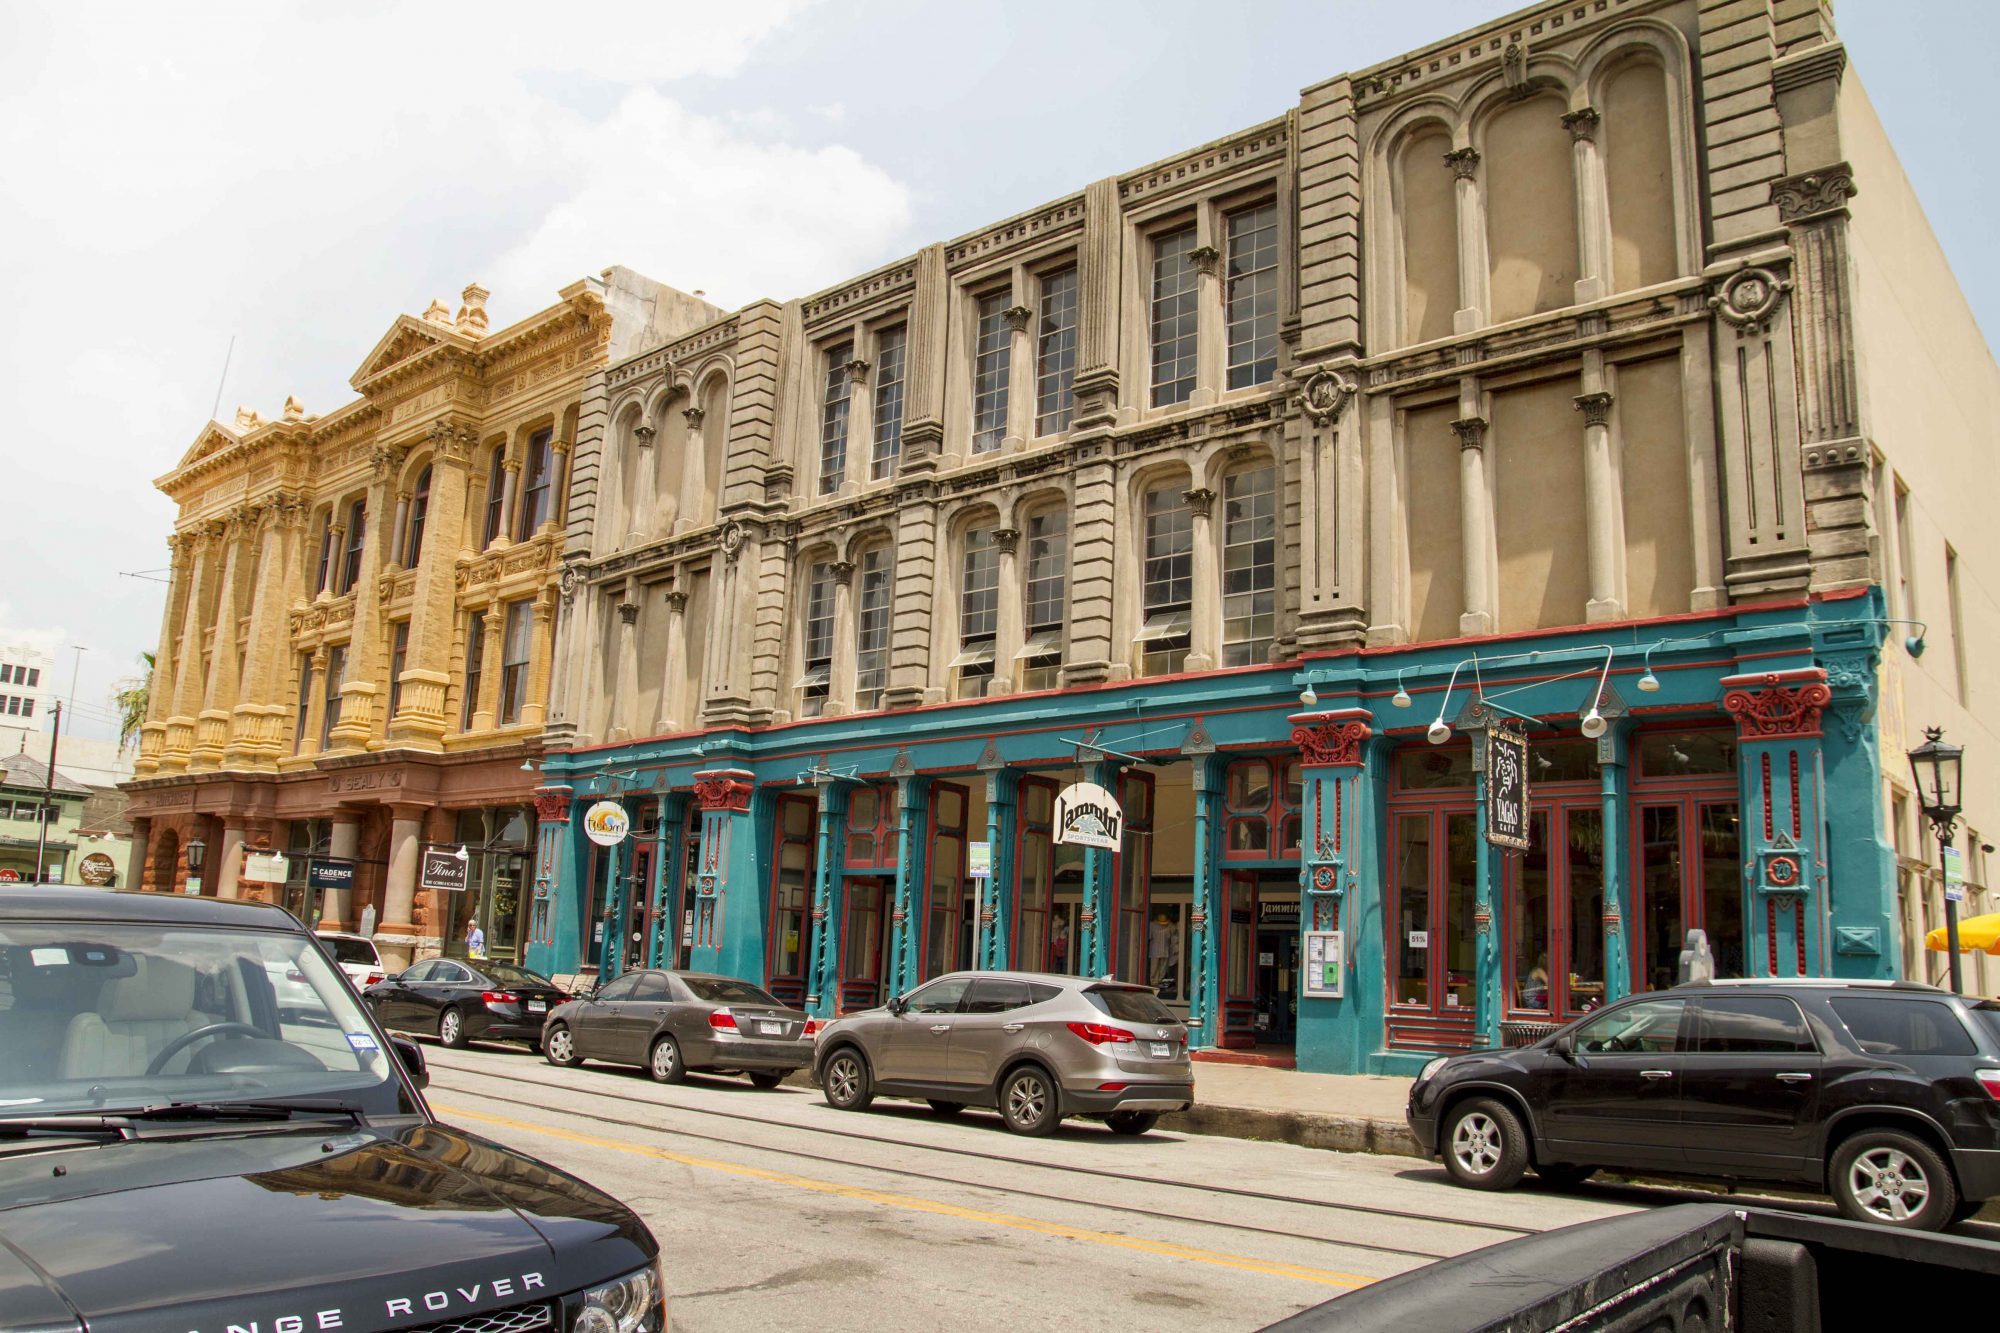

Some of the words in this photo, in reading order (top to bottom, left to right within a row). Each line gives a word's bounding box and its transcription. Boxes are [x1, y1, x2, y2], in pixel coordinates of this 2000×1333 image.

[345, 772, 385, 790] SEALY
[1058, 796, 1121, 841] Jammin'
[1496, 798, 1518, 825] YAGAS
[1067, 833, 1108, 844] SPORTSWEAR
[319, 868, 352, 878] CADENCE
[427, 860, 464, 878] Tina's
[1411, 934, 1425, 942] 51%
[386, 1272, 545, 1318] ROVER
